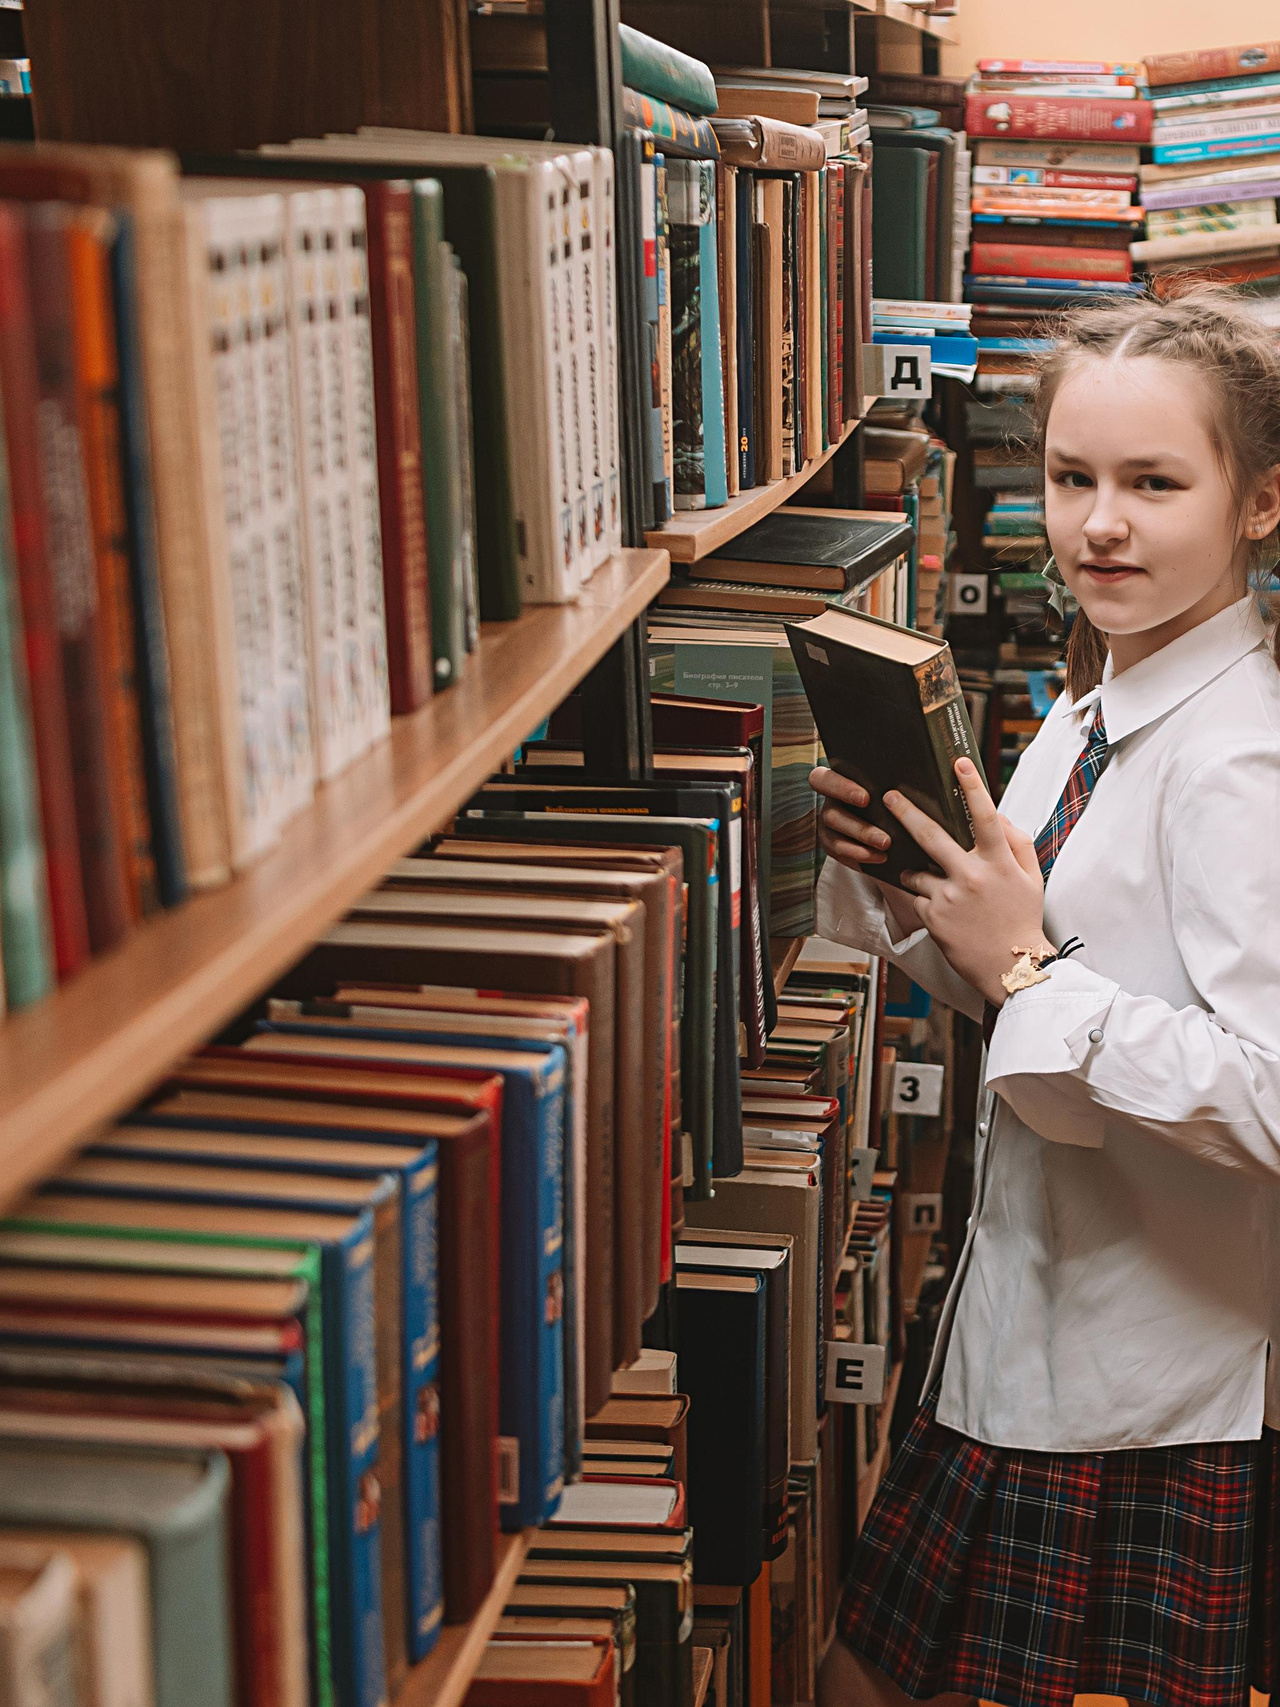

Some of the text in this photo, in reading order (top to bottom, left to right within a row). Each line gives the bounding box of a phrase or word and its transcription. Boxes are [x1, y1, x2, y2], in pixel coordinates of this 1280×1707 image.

[891, 355, 922, 391] Д
[740, 436, 749, 452] 20
[960, 585, 976, 604] О
[683, 671, 764, 682] Биография писателя
[946, 706, 961, 746] Униженные
[751, 903, 764, 1017] ДОСТОЕВСКИЙ
[915, 1205, 935, 1223] П
[836, 1358, 864, 1390] Е
